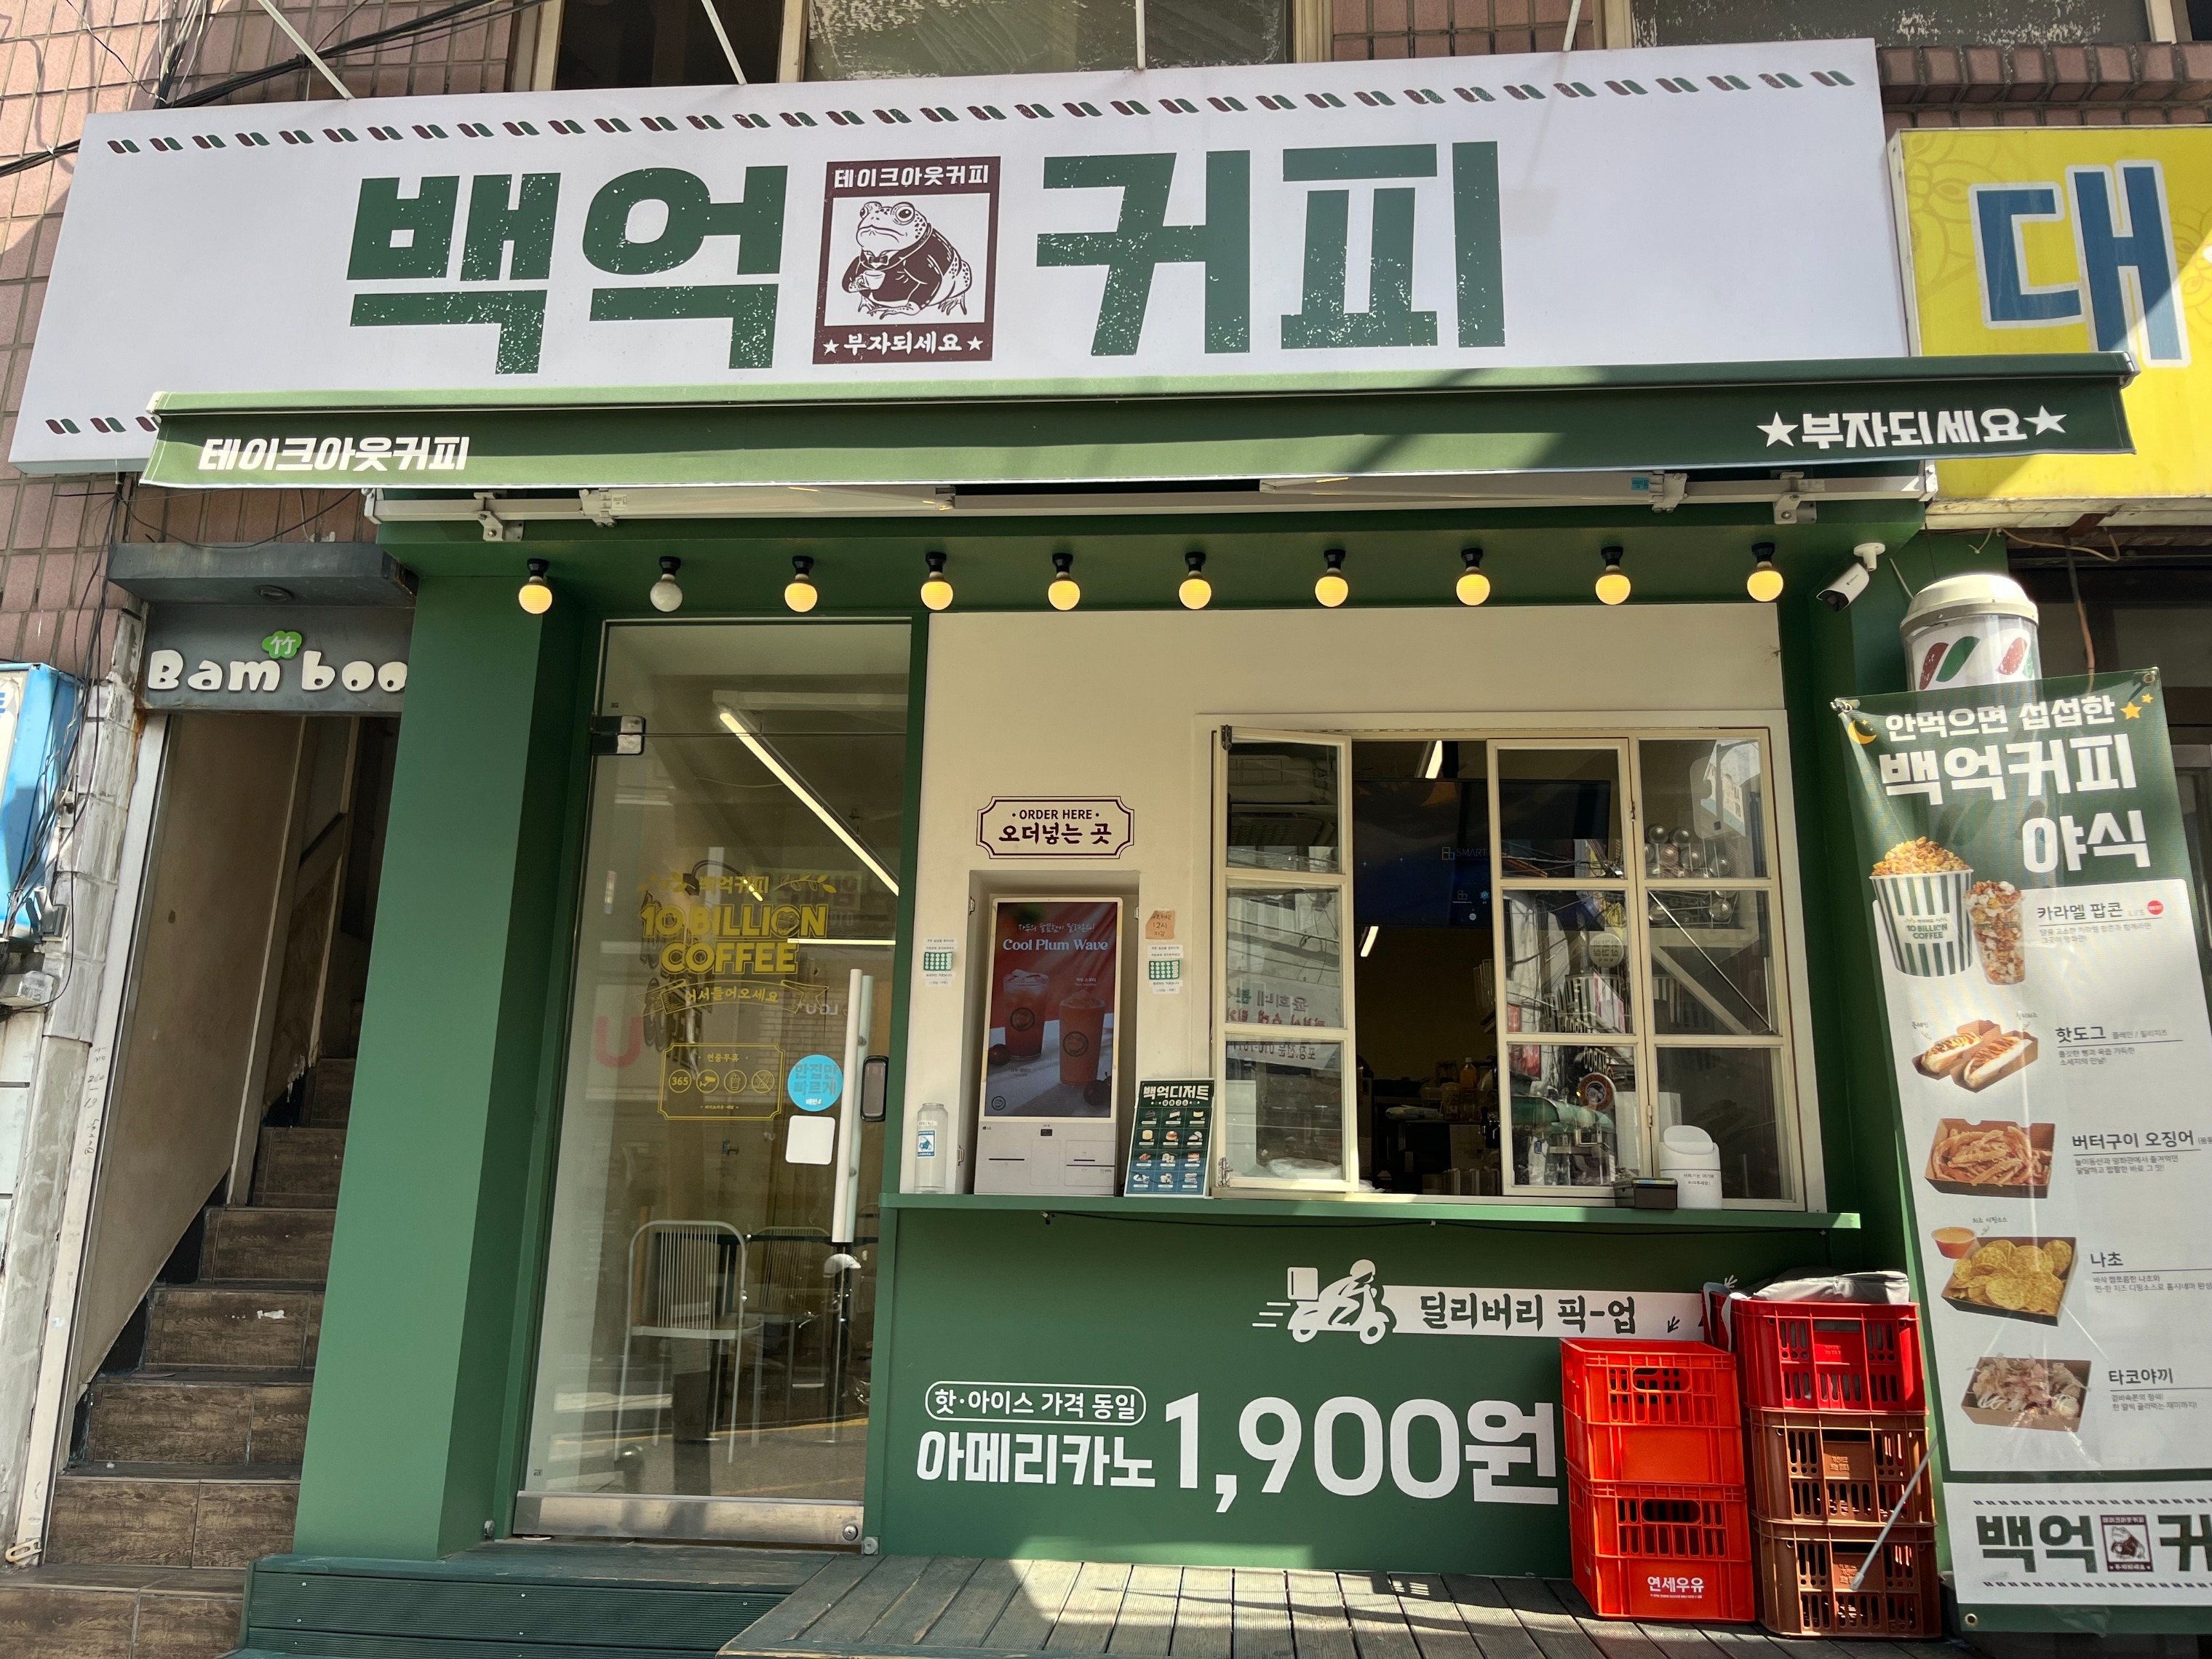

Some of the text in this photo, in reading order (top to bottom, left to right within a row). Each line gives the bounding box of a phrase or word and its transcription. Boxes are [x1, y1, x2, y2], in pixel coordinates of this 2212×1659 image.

[834, 163, 990, 189] 테이크아웃커피
[347, 140, 1505, 375] 백억 커피
[1968, 159, 2191, 368] 대
[843, 330, 963, 357] 부자되세요
[1801, 408, 2028, 450] 부자되세요
[197, 436, 471, 472] 테이크아웃커피
[268, 635, 297, 656] 竹
[1885, 695, 2115, 741] 안먹으면 섭섭한
[1879, 733, 2137, 805] 백억커피
[1019, 808, 1092, 820] ORDER HERE
[998, 823, 1112, 846] 오더넣는 곳
[2022, 810, 2151, 873] 야식
[641, 904, 829, 939] 10 BILLION
[2037, 903, 2086, 920] 카라멜
[2090, 902, 2123, 918] 팝콘
[1003, 939, 1109, 950] Cool Plum Wave
[1913, 931, 1944, 939] COFFEE
[660, 939, 799, 975] COFFEE
[685, 984, 780, 1003] 어서들어오세요
[2055, 1026, 2106, 1043] 핫도그
[671, 1076, 688, 1086] 365
[1143, 1085, 1209, 1101] 백억디저트
[2072, 1132, 2139, 1150] 버터구이
[2145, 1130, 2195, 1147] 오징어
[2090, 1252, 2123, 1268] 나초
[1419, 1291, 1636, 1334] 딜리버리 픽-업
[2109, 1368, 2173, 1385] 타코야끼
[934, 1388, 1137, 1420] 핫·아이스 가격 동일
[916, 1392, 1559, 1513] 아메리카노 1,900원
[1976, 1513, 2212, 1573] 백억 커
[1647, 1576, 1704, 1593] 연세우유
